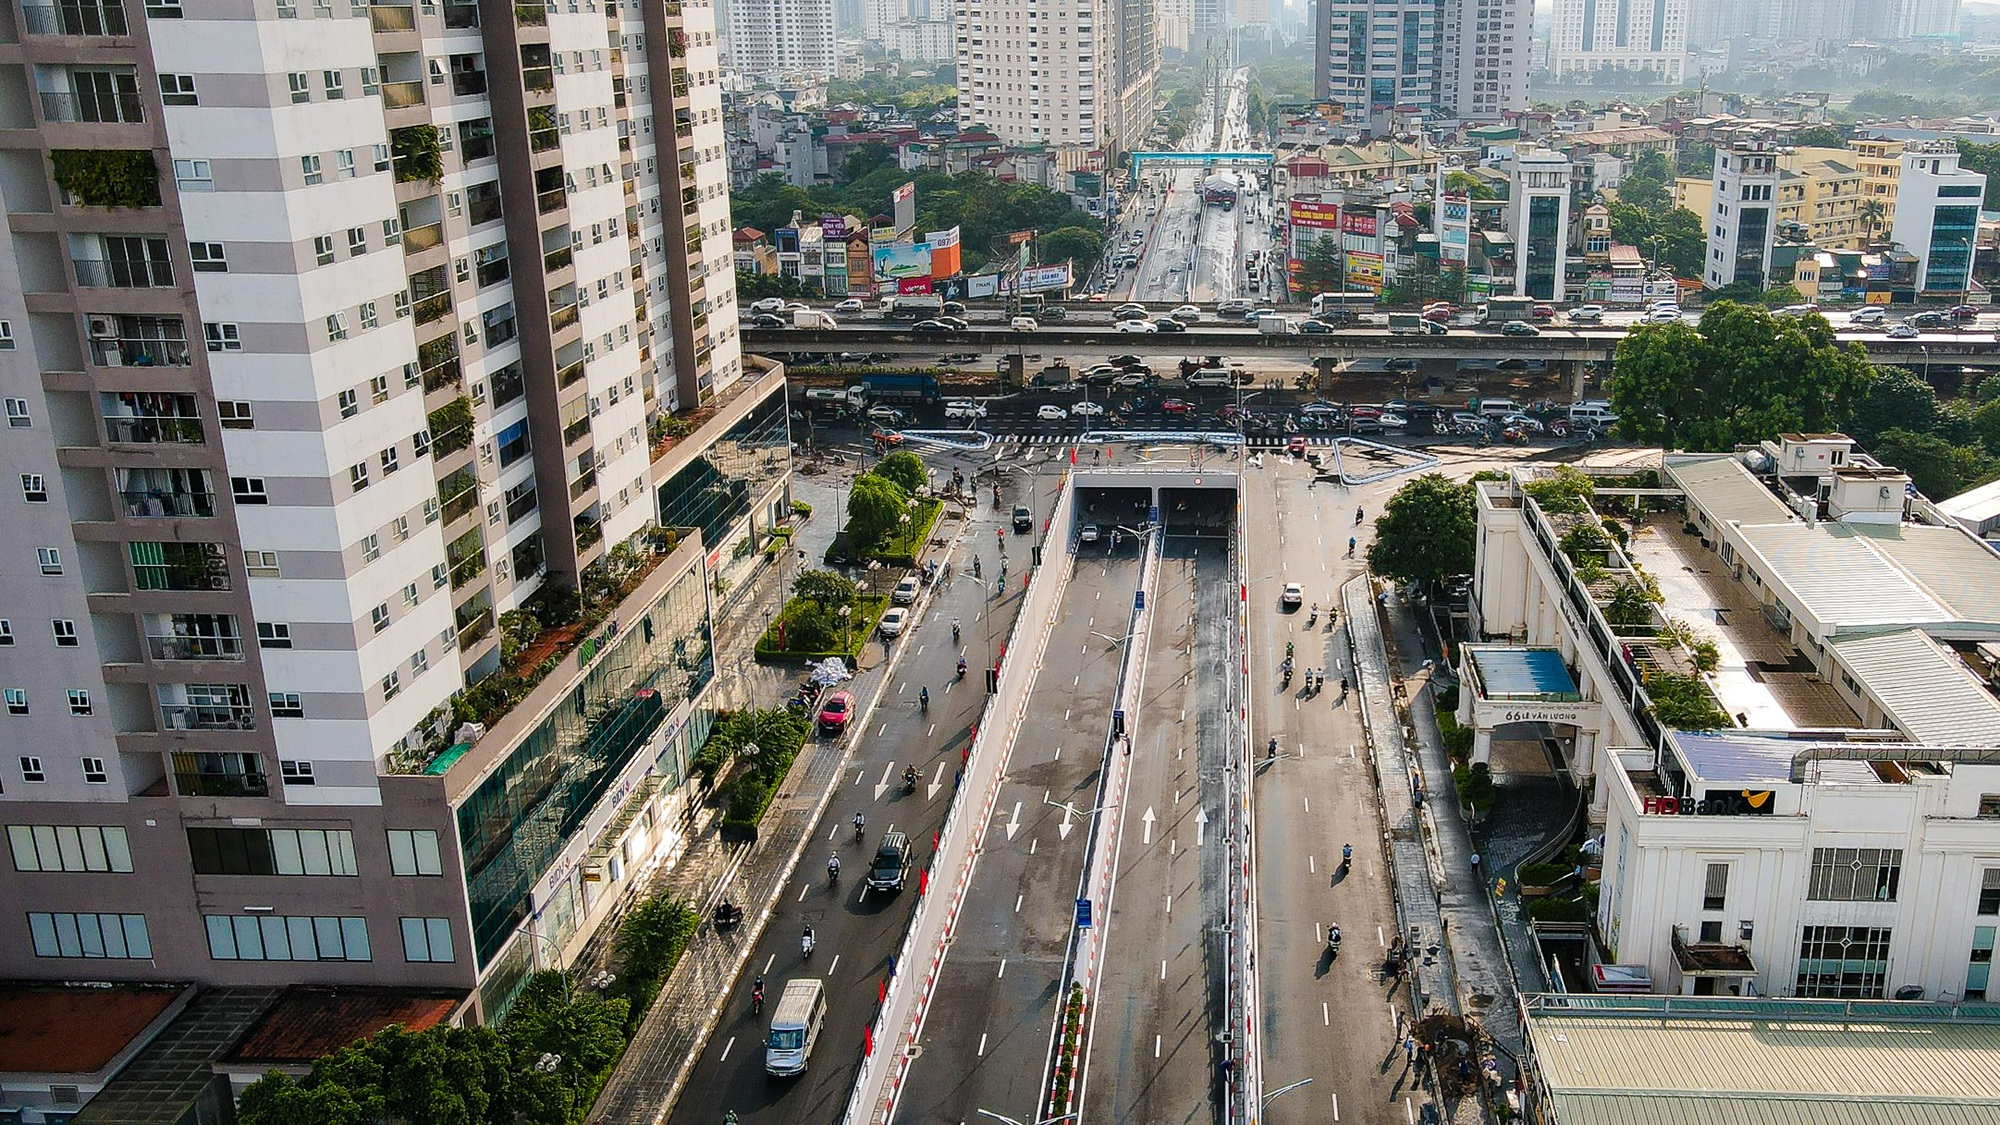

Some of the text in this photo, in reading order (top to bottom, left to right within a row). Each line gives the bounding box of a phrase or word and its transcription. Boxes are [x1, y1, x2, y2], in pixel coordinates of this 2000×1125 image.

[1505, 711, 1521, 721] 66
[1522, 712, 1530, 720] LÊ
[1532, 712, 1548, 720] VĂN
[664, 722, 676, 742] BIDV
[612, 786, 626, 808] BIDV
[1643, 795, 1742, 816] HDBank
[548, 862, 565, 890] BIDV
